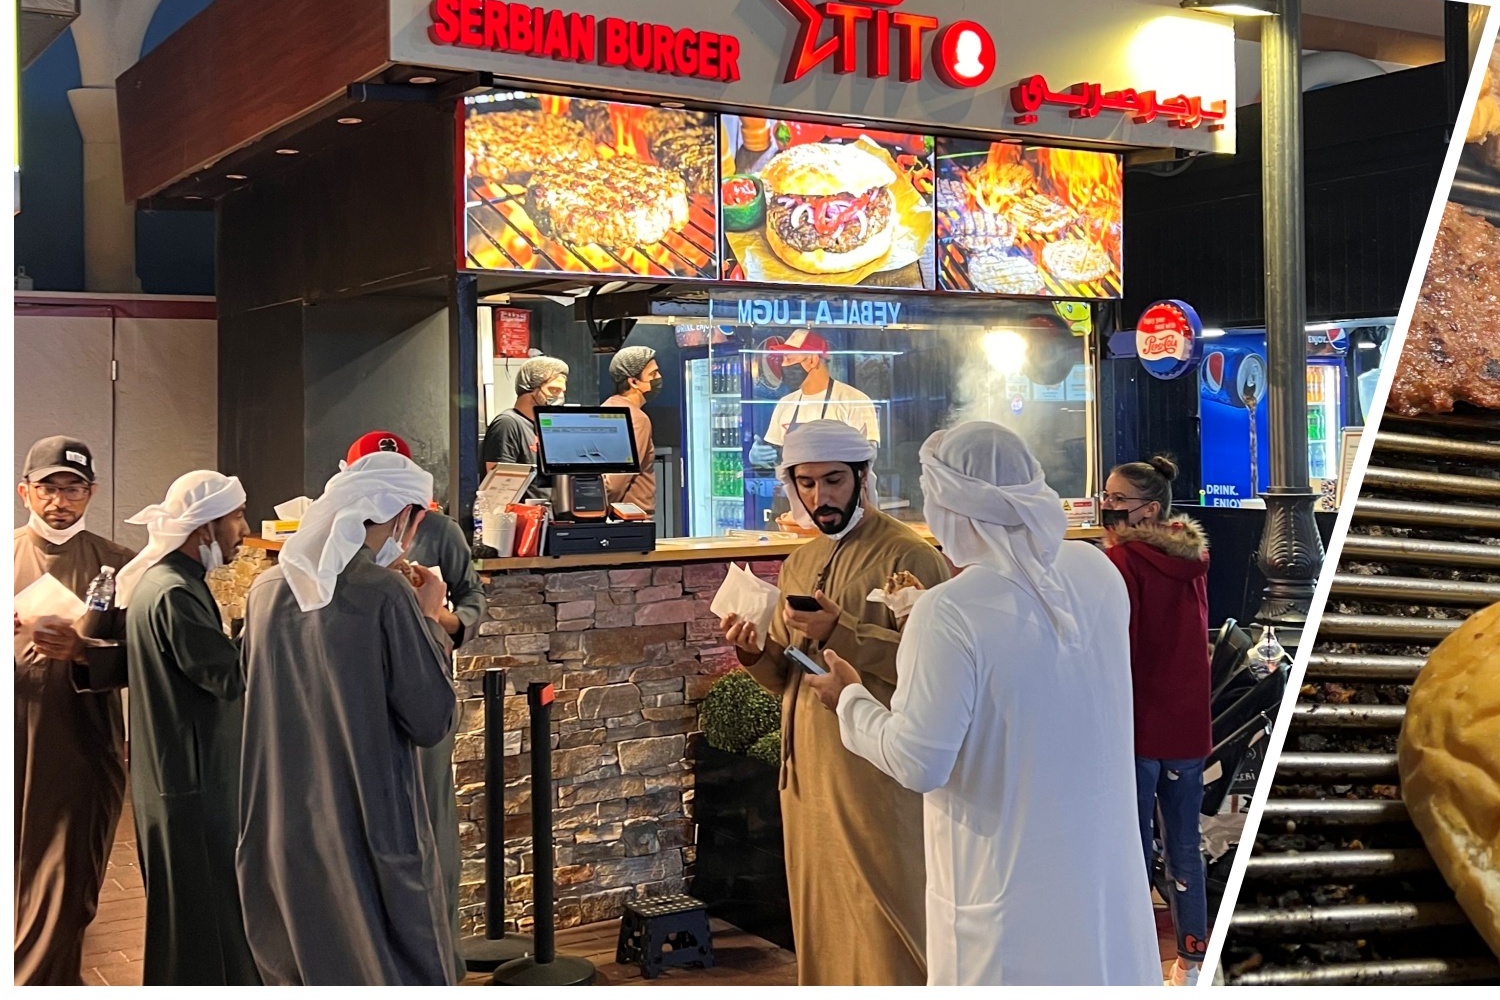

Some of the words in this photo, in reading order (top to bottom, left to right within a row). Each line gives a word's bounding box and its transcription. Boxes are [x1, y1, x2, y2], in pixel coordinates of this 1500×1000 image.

[598, 17, 740, 83] BURGER
[827, 2, 996, 88] TITO
[1206, 484, 1239, 496] DRINK.
